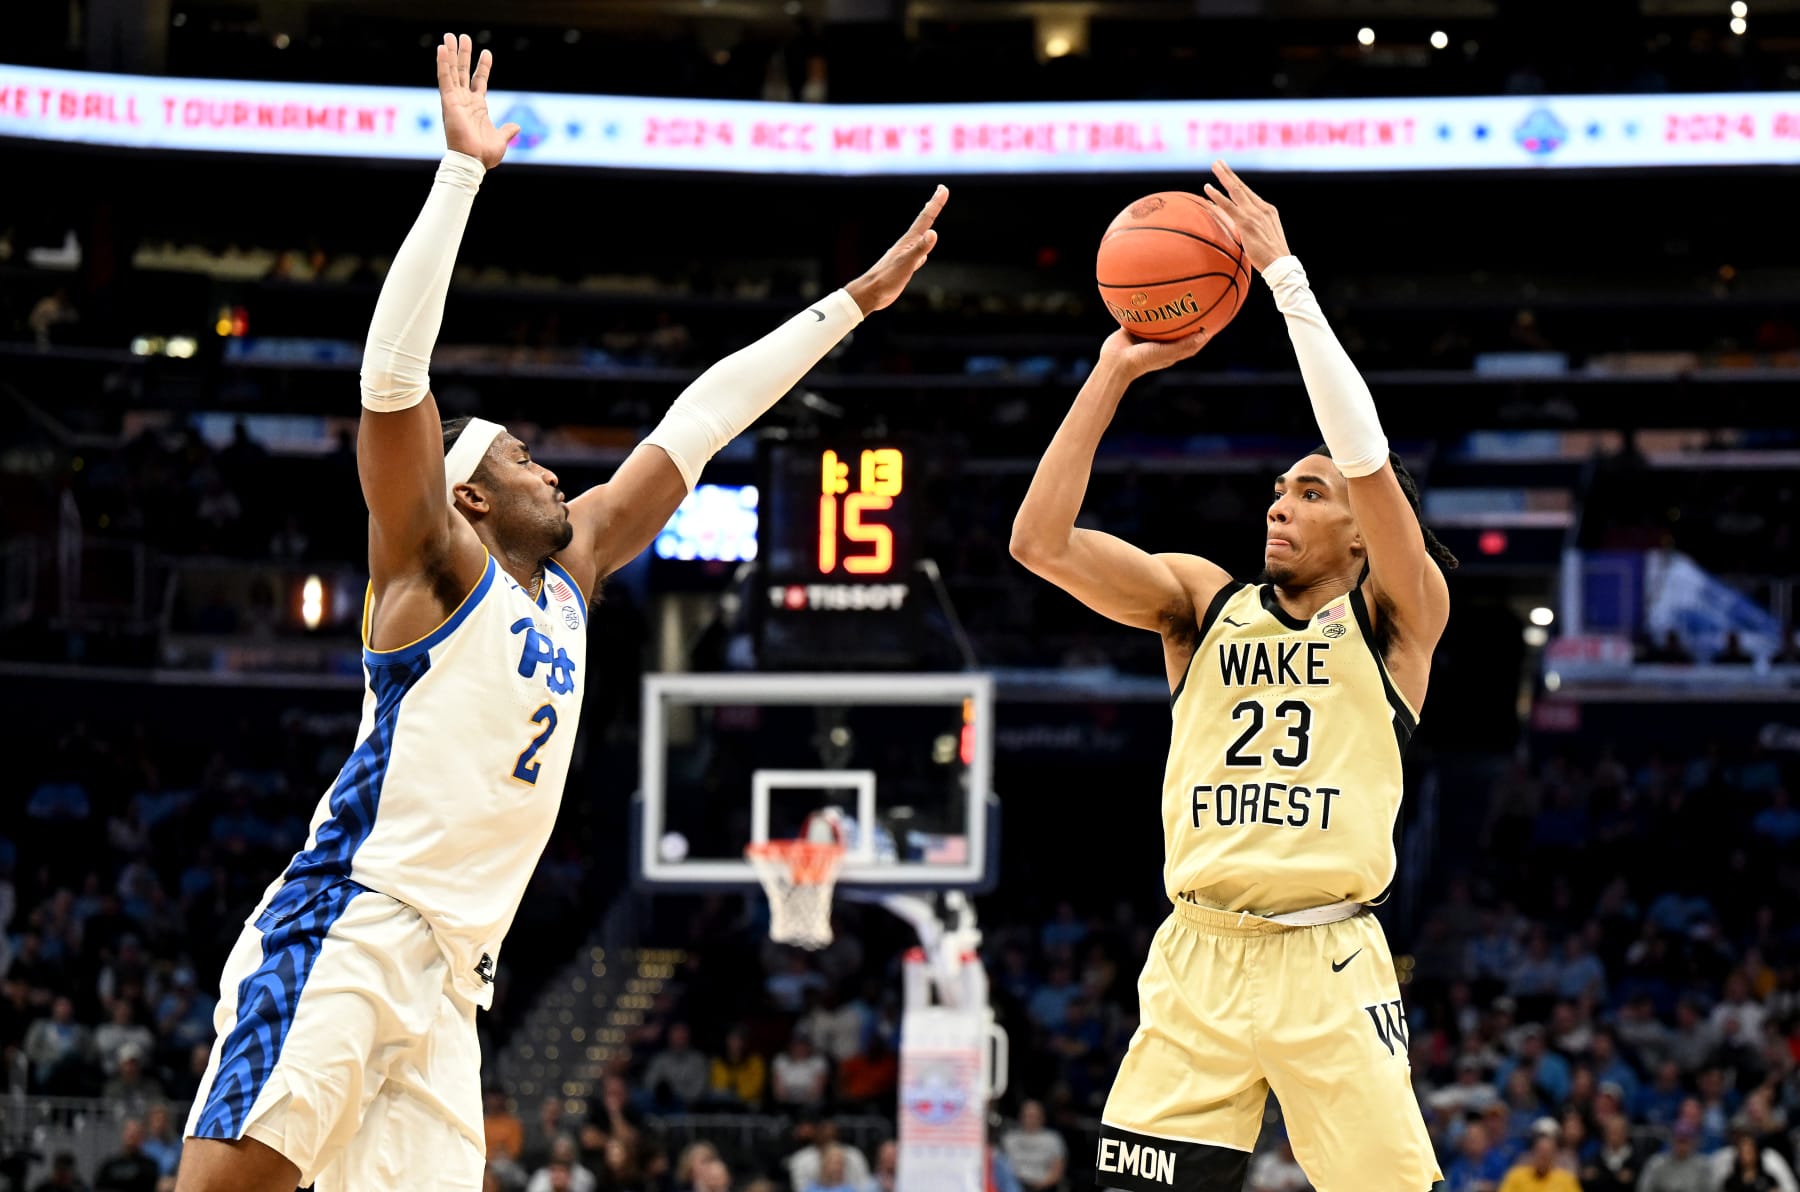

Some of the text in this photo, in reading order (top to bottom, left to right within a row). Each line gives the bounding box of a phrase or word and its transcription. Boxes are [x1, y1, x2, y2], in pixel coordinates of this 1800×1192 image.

[162, 96, 397, 133] TOURNAMENT
[644, 116, 1415, 153] 2024 ACC MEN'S BASKETBALL TOURNAMENT
[1664, 113, 1755, 144] 2024
[822, 448, 903, 496] 1:13
[818, 491, 894, 574] 15
[808, 584, 907, 610] TISSOT
[1218, 641, 1331, 687] WAKE
[511, 702, 558, 787] 2
[1225, 699, 1312, 768] 23
[1192, 782, 1341, 830] FOREST
[1096, 1137, 1176, 1186] EMON
